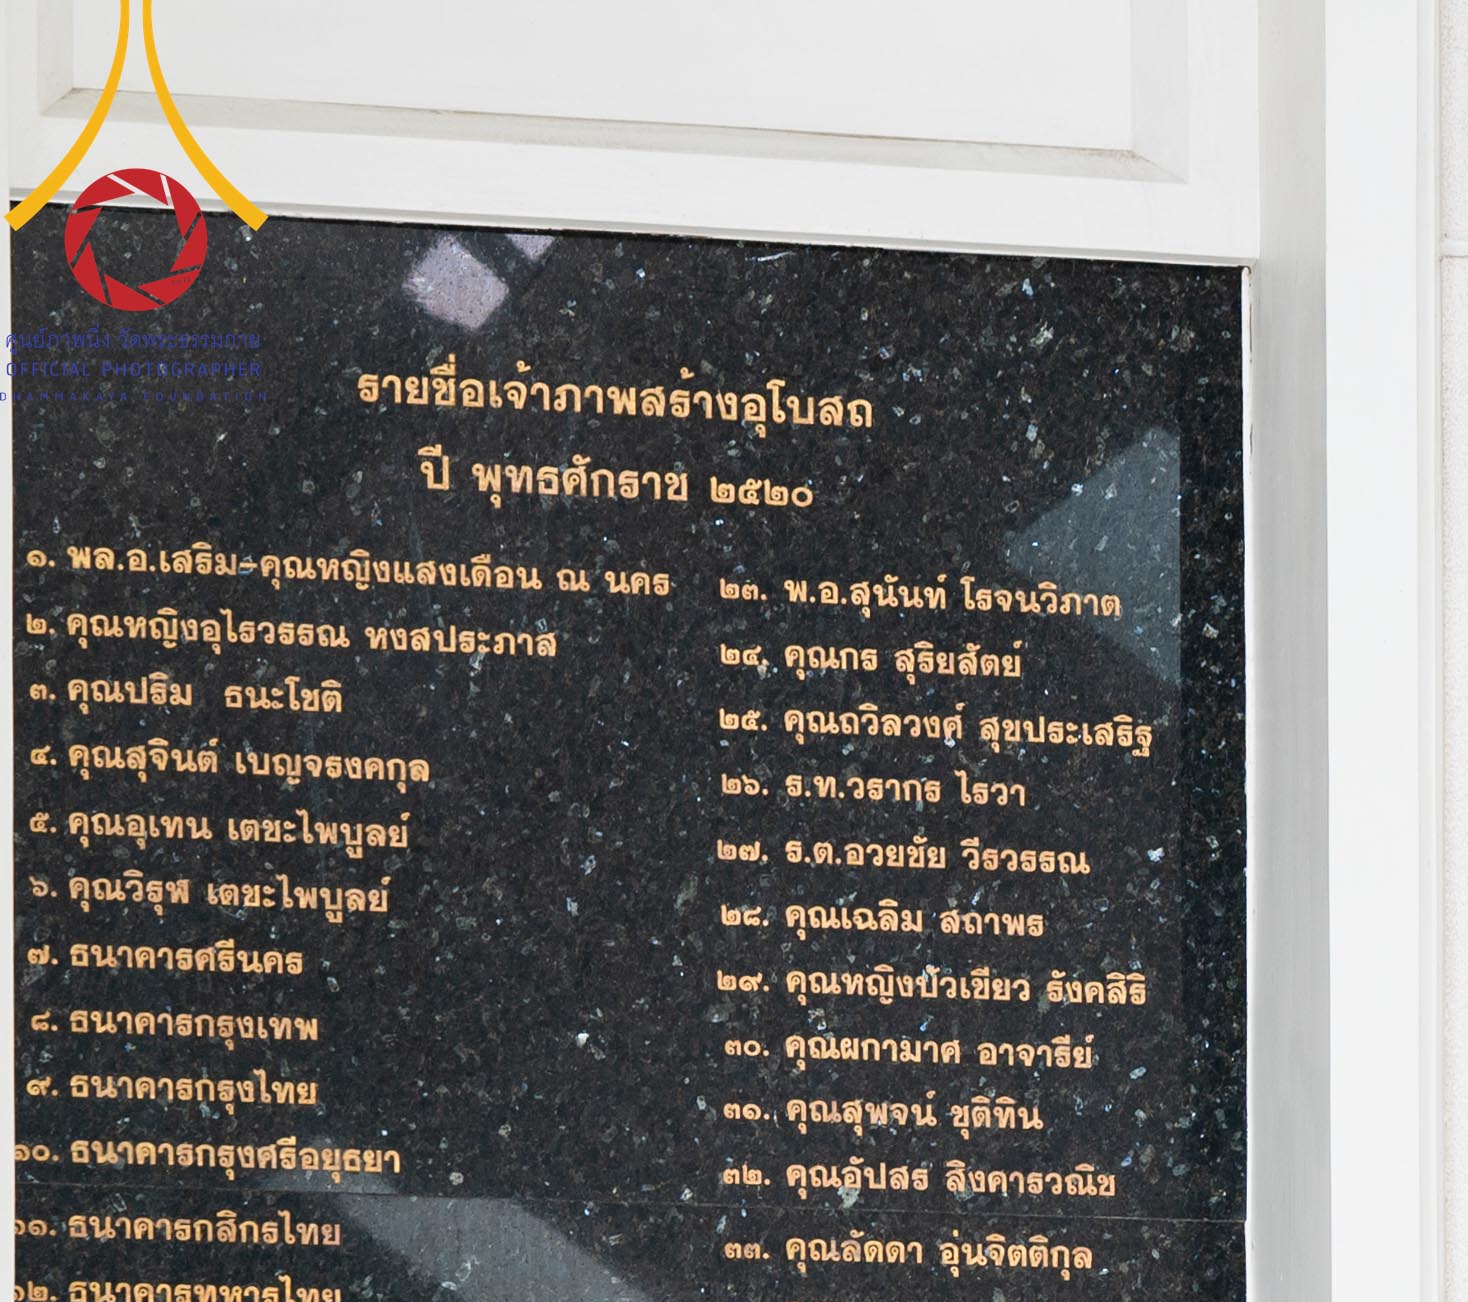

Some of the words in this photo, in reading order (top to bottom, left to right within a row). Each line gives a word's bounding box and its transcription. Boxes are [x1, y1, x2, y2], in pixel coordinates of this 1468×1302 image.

[357, 353, 873, 438] รายชื่อเจ้าภาพสร้างอุโบสถ
[417, 444, 451, 491] ปี
[472, 454, 688, 509] พุทธศักราช
[710, 476, 813, 507] ๒๕๒๐
[26, 550, 56, 567] ๑.
[556, 569, 591, 592] ณ
[604, 571, 669, 596] นคร
[720, 578, 767, 601] ๒๓.
[784, 574, 947, 619] พ.อ.สุนันท์
[960, 576, 1120, 616] โรจนวิภาต
[26, 613, 56, 635] ๒.
[67, 608, 350, 655] คุณหญิงอุไรวรรณ
[365, 625, 557, 656] หงสประภาส
[720, 644, 767, 667] ๒๔.
[784, 645, 878, 680] คุณกร
[895, 640, 1023, 685] สุริยสัตย์
[29, 684, 56, 701] ๓.
[68, 672, 192, 715] คุณปริม
[224, 676, 342, 713] ธนะโชติ
[719, 708, 768, 731] ๒๕.
[784, 702, 964, 745] คุณถวิลวงศ์
[980, 714, 1152, 757] สุขประเสริฐ
[30, 745, 57, 765] ๔.
[68, 737, 219, 783] คุณสุจินต์
[235, 752, 430, 794] เบญจรงคกุล
[721, 773, 768, 795] ๒๖.
[786, 775, 941, 803] ร.ท.วรากร
[954, 770, 1025, 806] ไรวา
[29, 812, 57, 833] ๕.
[68, 812, 213, 849] คุณอุเทน
[228, 808, 411, 859] เตชะไพบูลย์
[717, 840, 768, 861] ๒๗.
[785, 836, 946, 868] ร.ต.อวยชัย
[960, 837, 1091, 874] วีรวรรณ
[30, 876, 58, 896] ๖.
[69, 869, 190, 916] คุณวิรุฬ
[208, 874, 391, 923] เตชะไพบูลย์
[720, 904, 768, 926] ๒๘.
[786, 898, 923, 941] คุณเฉลิม
[940, 909, 1044, 937] สถาพร
[27, 945, 58, 965] ๗.
[70, 939, 304, 975] ธนาคารศรีนคร
[717, 970, 769, 992] ๒๙.
[786, 964, 1030, 1006] คุณหญิงบัวเขียว
[1046, 970, 1146, 1005] รังคสิริ
[31, 1010, 58, 1031] ๘.
[70, 1010, 318, 1051] ธนาคารกรุงเทพ
[724, 1040, 769, 1056] ๓๐.
[785, 1035, 961, 1071] คุณผกามาศ
[977, 1034, 1094, 1069] อาจารีย์
[26, 1076, 58, 1096] ๙.
[70, 1069, 318, 1115] ธนาคารกรุงไทย
[723, 1103, 770, 1120] ๓๑.
[786, 1091, 937, 1136] คุณสุพจน์
[950, 1095, 1044, 1140] ชุติทิน
[70, 1136, 400, 1184] ธนาคารกรุงศรีอยุธยา
[723, 1164, 771, 1185] ๓๒.
[786, 1156, 928, 1200] คุณอัปสร
[946, 1160, 1115, 1197] สิงคารวณิช
[68, 1209, 341, 1245] ธนาคารกสิกรไทย
[724, 1242, 769, 1259] ๓๓.
[786, 1229, 923, 1273] คุณลัดดา
[940, 1229, 1092, 1280] อุ่นจิตติกุล
